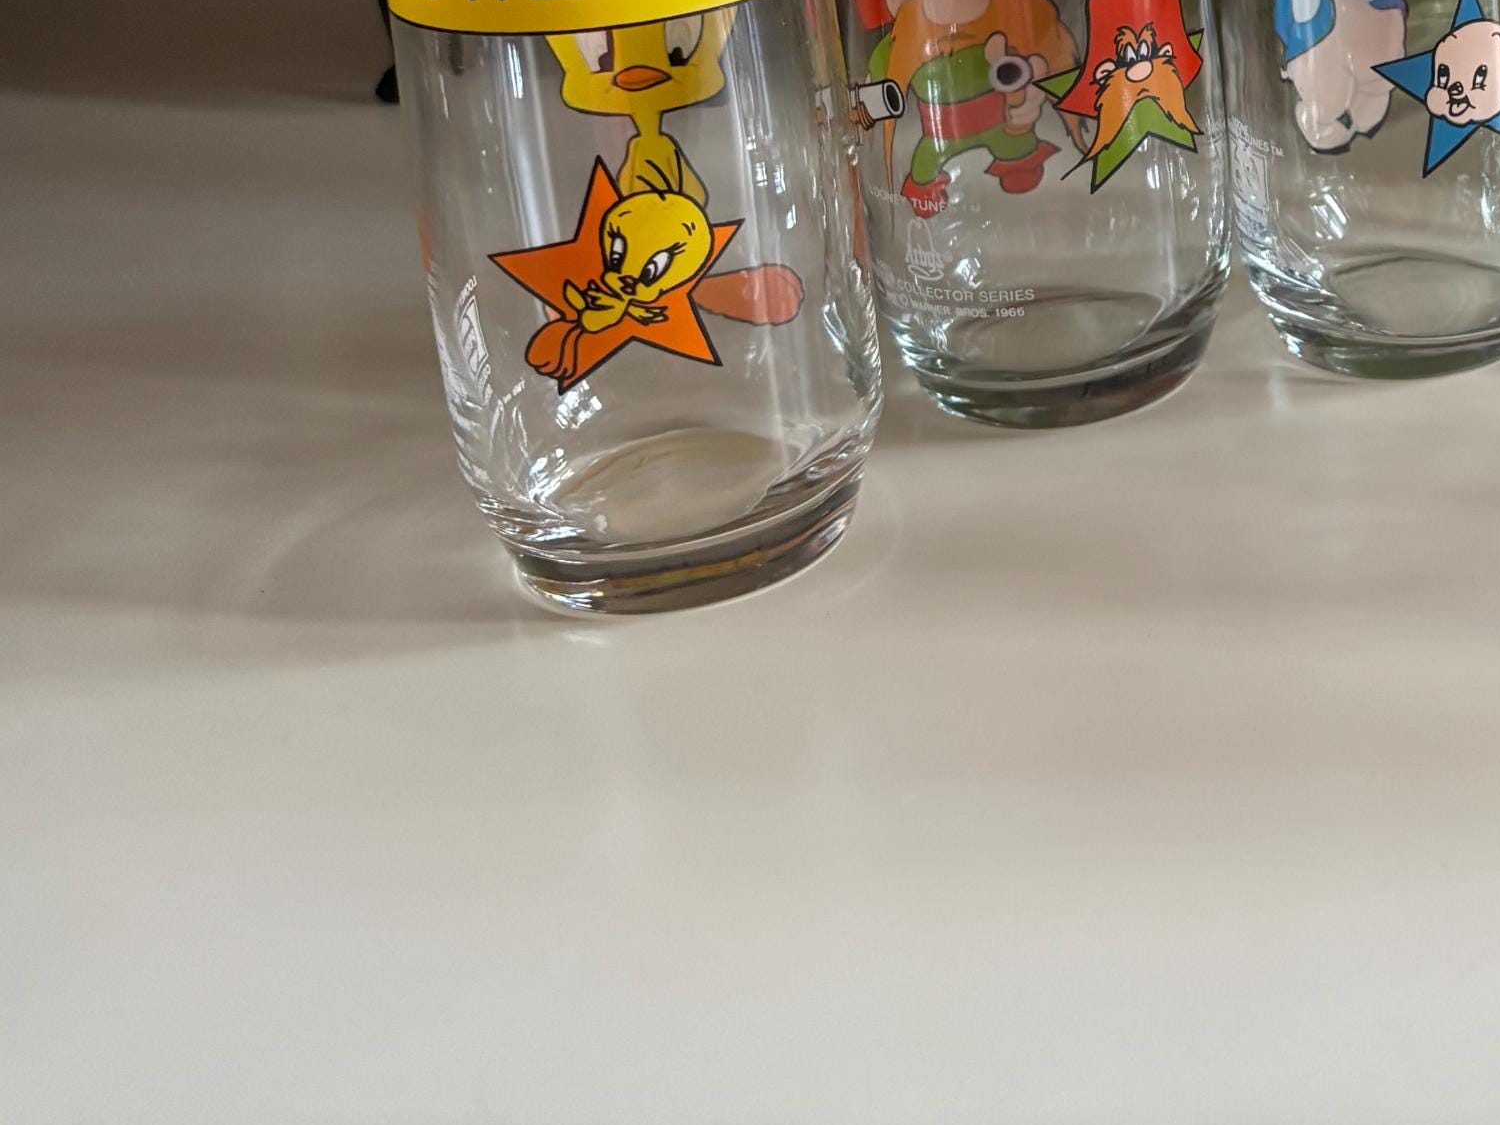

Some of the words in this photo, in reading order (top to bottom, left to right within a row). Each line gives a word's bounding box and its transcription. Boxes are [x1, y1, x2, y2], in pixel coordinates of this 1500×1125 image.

[896, 277, 974, 302] COLLECTOR
[978, 288, 1035, 303] SERIES
[910, 298, 951, 316] WARNER
[994, 306, 1026, 319] 1966
